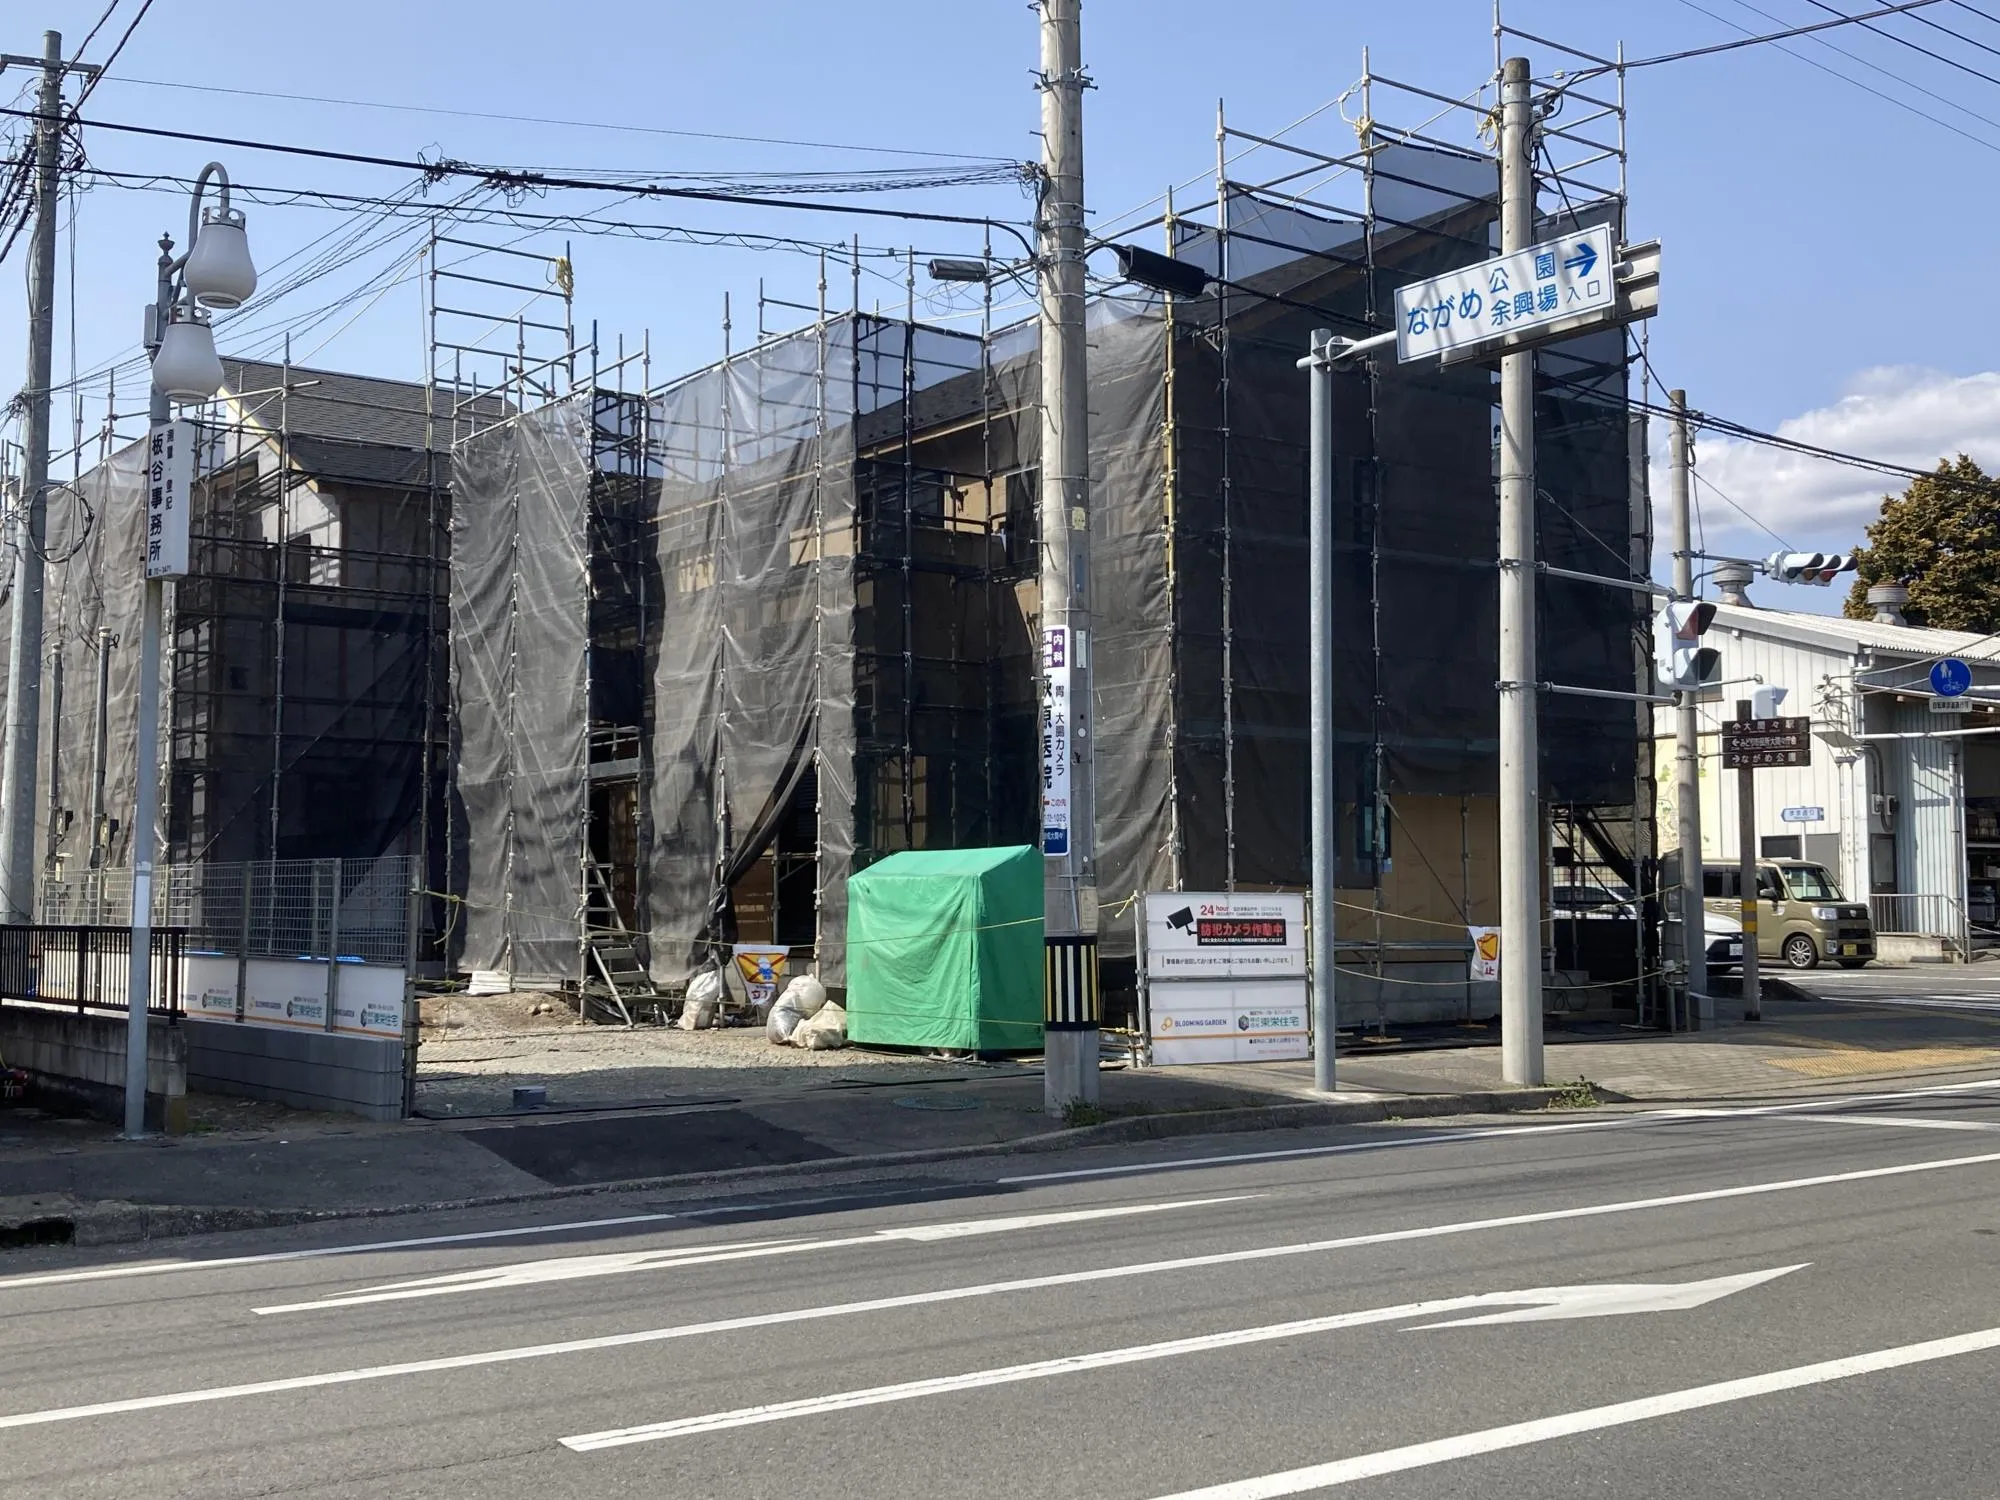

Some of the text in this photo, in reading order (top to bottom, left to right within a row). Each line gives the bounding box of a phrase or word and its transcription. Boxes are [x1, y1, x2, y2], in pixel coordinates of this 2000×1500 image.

[1488, 251, 1556, 295] 公園
[1490, 278, 1601, 327] 余興場 入口
[1407, 287, 1483, 336] ながめ
[149, 432, 164, 563] 板谷事務所
[1053, 634, 1063, 663] 内科
[1741, 751, 1797, 764] ながめ公園
[1051, 798, 1067, 807] この先
[1200, 904, 1215, 916] 24
[1215, 904, 1229, 912] hour
[1200, 922, 1283, 937] 防犯カメラ作動中
[1175, 1018, 1227, 1028] BLOOMING GARDEN
[1260, 1016, 1299, 1027] 東栄住宅
